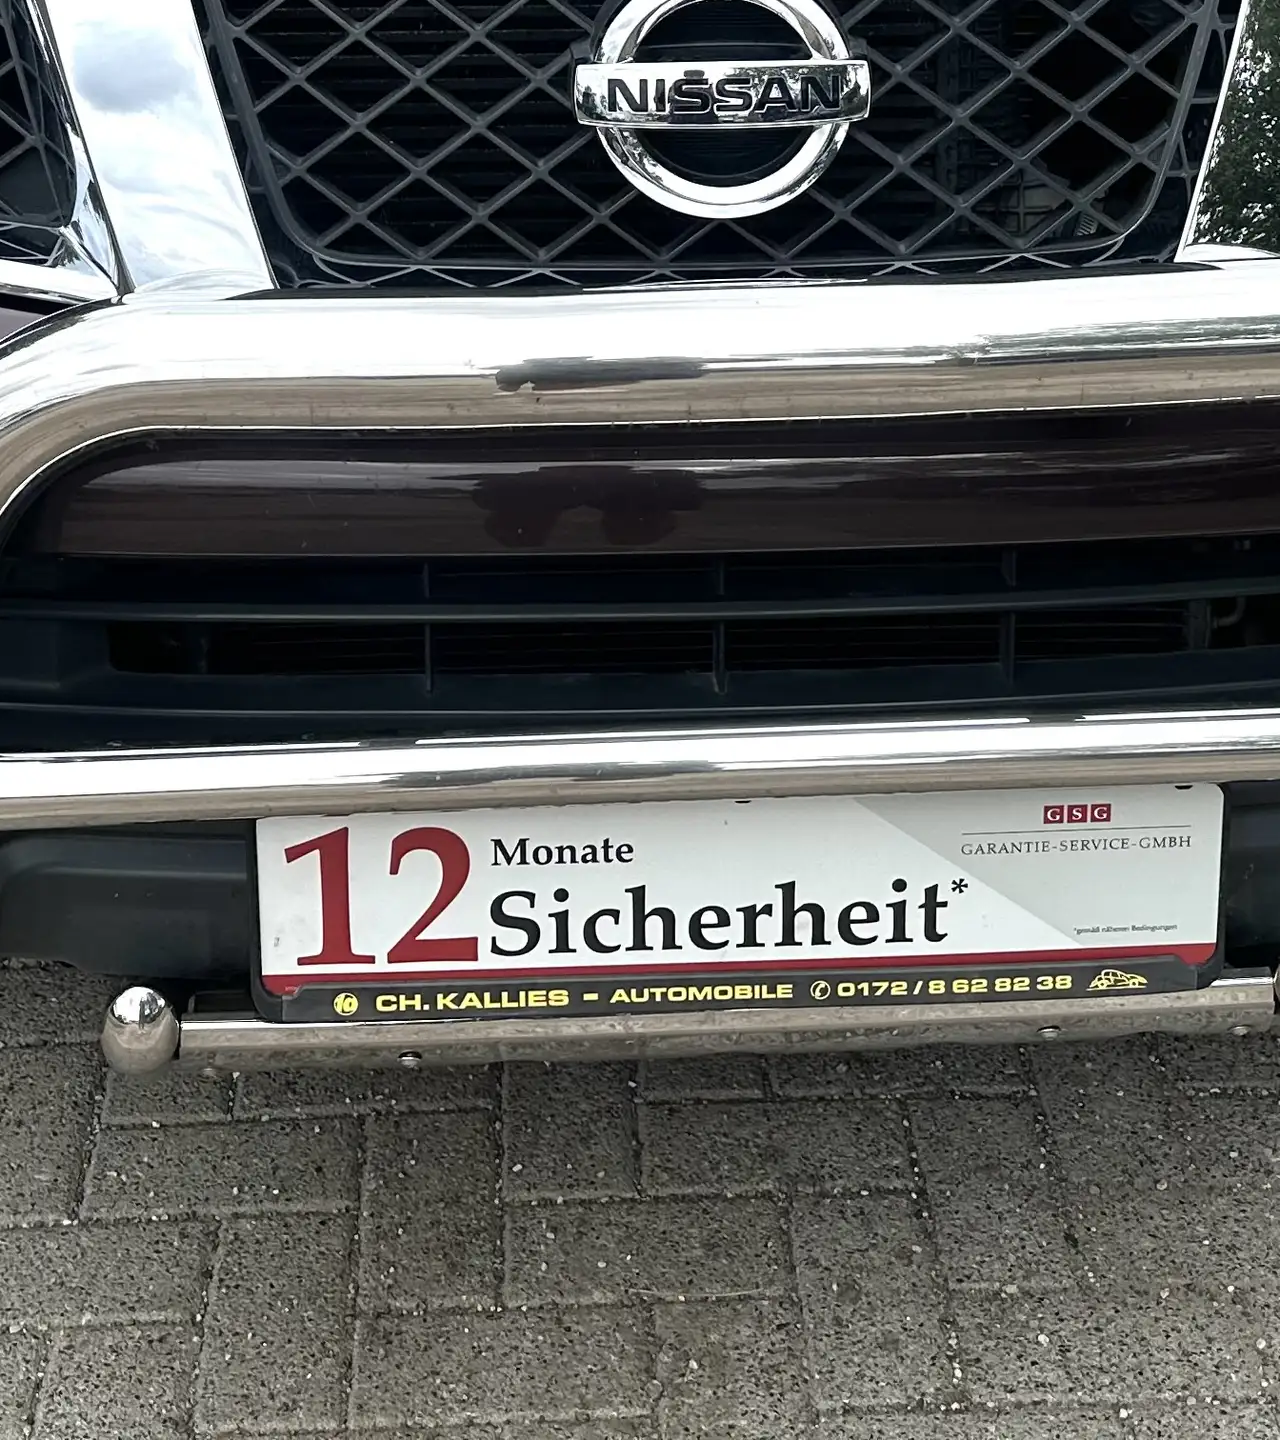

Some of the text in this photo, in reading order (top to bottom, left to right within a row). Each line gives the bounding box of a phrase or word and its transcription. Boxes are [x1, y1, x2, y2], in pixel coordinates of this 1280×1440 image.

[606, 73, 841, 115] NISSAN
[1046, 805, 1109, 822] GSG
[490, 837, 635, 866] Monate
[961, 836, 1192, 856] GARANTIE-SERVICE-GMBH
[284, 826, 479, 966] 12
[375, 994, 429, 1011] CH.
[437, 989, 569, 1009] KALLIES
[609, 984, 793, 1003] AUTOMOBILE
[952, 978, 987, 993] 62
[994, 976, 1030, 991] 82
[1036, 975, 1072, 989] 38
